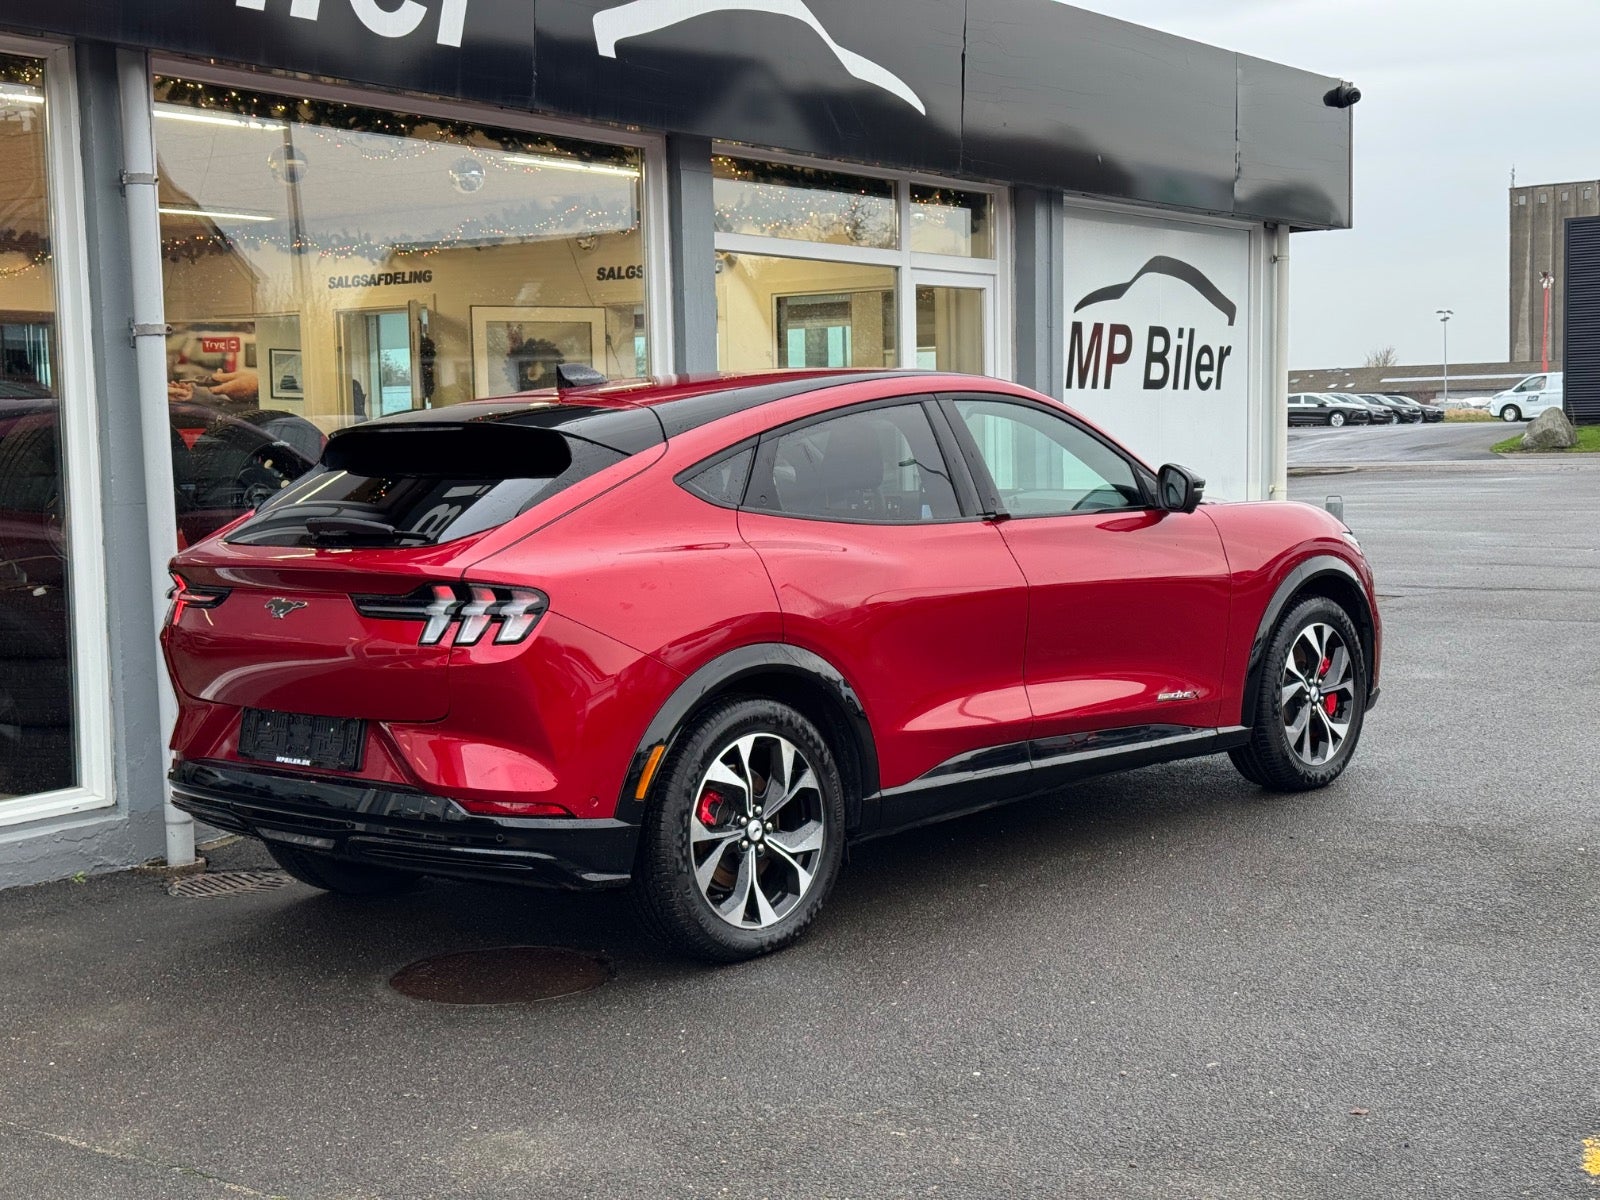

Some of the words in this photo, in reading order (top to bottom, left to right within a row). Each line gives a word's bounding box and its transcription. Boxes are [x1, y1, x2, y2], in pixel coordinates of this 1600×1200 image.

[327, 269, 433, 290] SALGSAFDELING
[204, 340, 226, 350] Tryg
[1065, 320, 1133, 390] MP
[1142, 325, 1232, 391] Biler
